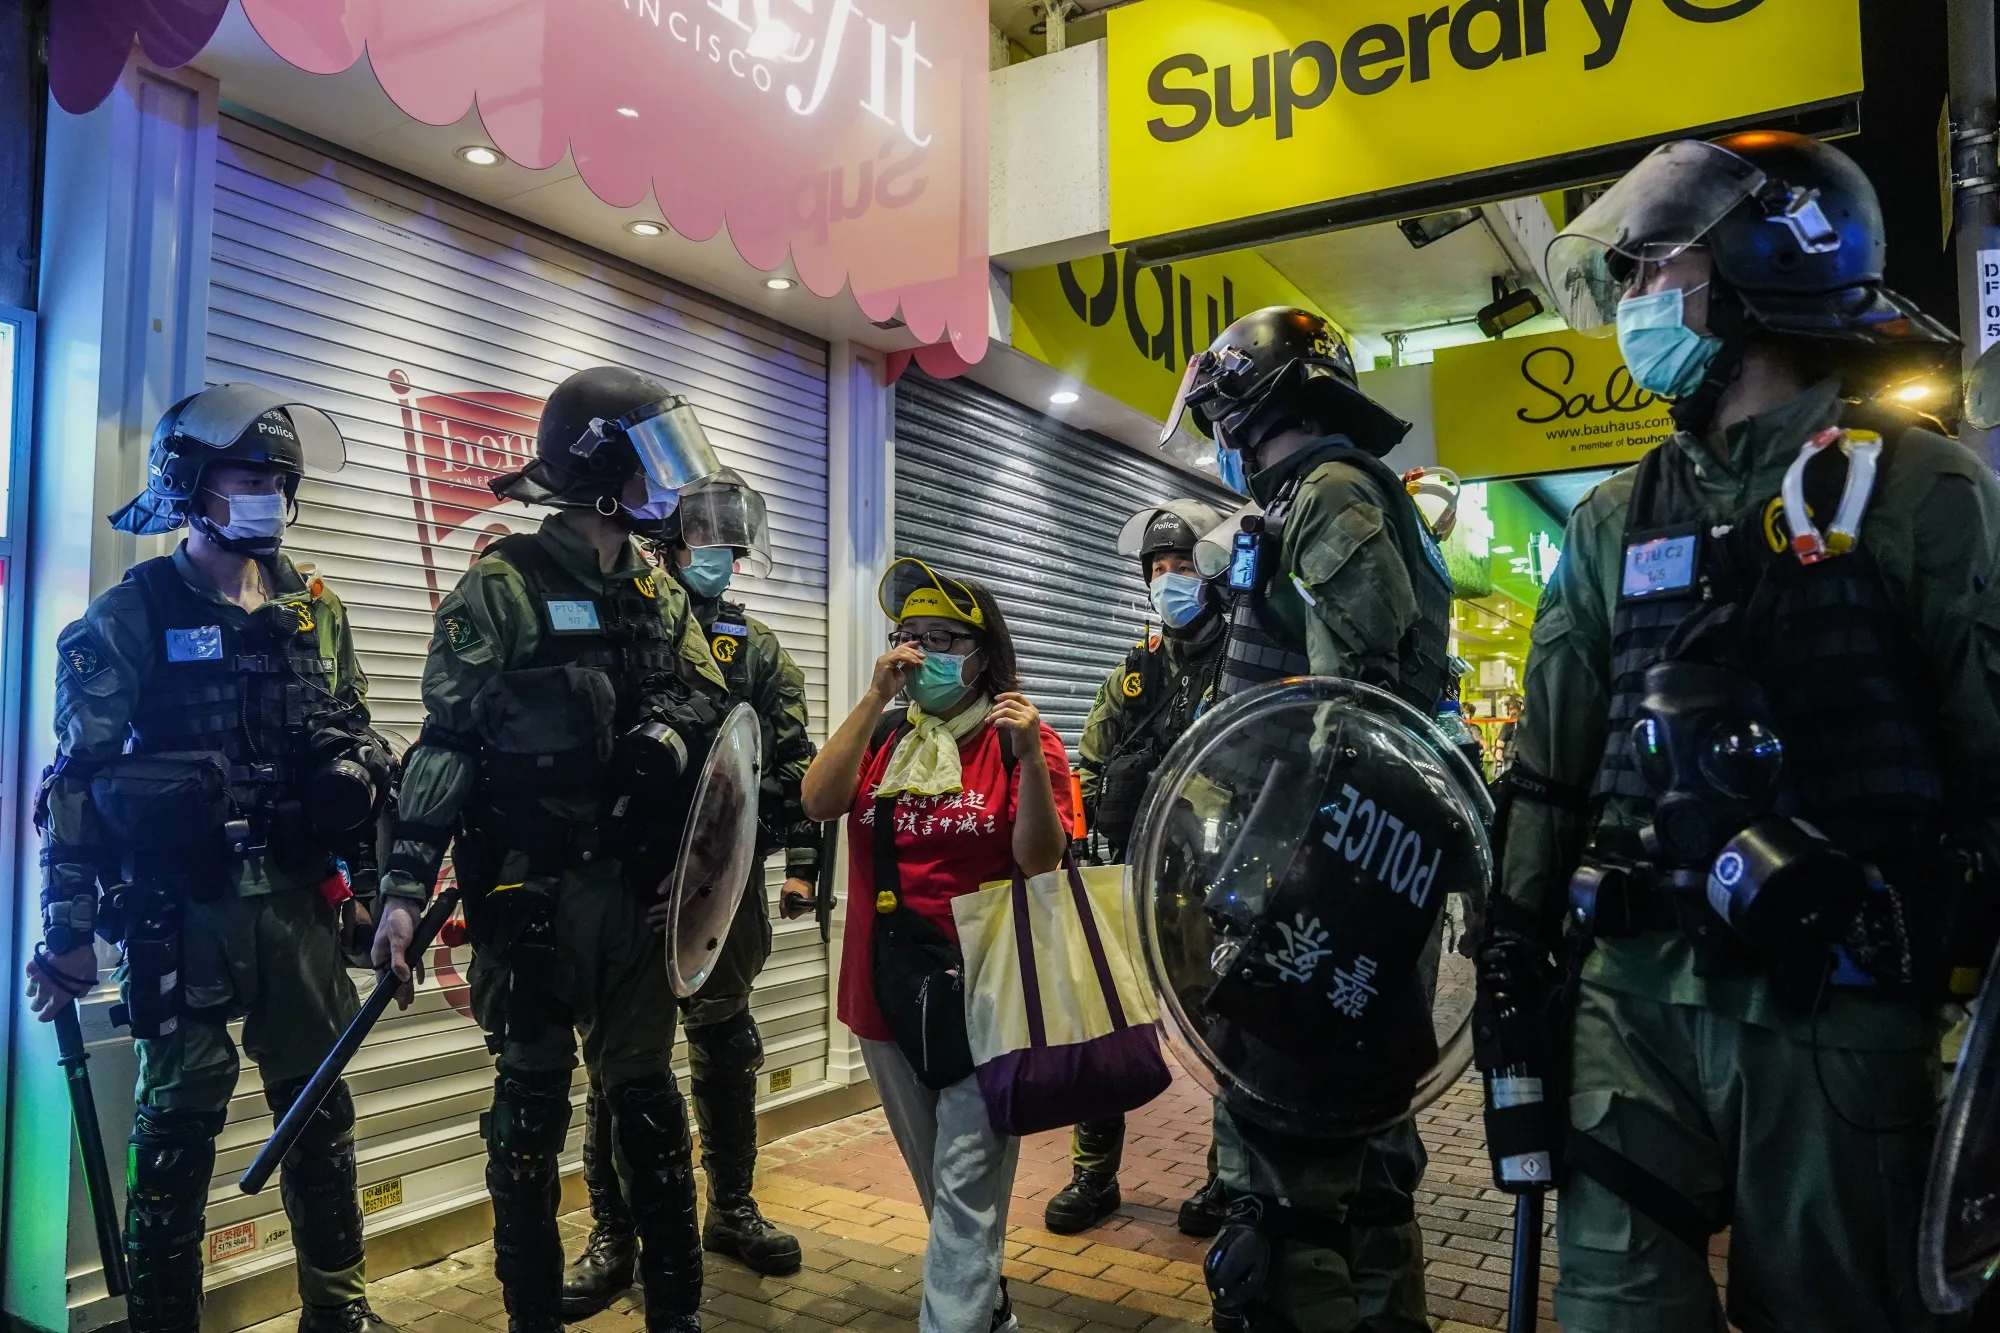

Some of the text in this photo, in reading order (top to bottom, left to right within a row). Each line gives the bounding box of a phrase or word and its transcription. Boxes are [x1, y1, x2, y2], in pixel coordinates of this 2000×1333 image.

[257, 422, 295, 441] Police
[1578, 439, 1613, 451] member
[1615, 438, 1625, 447] of
[1153, 521, 1179, 531] Police
[1322, 783, 1442, 908] POLICE
[1264, 912, 1379, 1019] 警察
